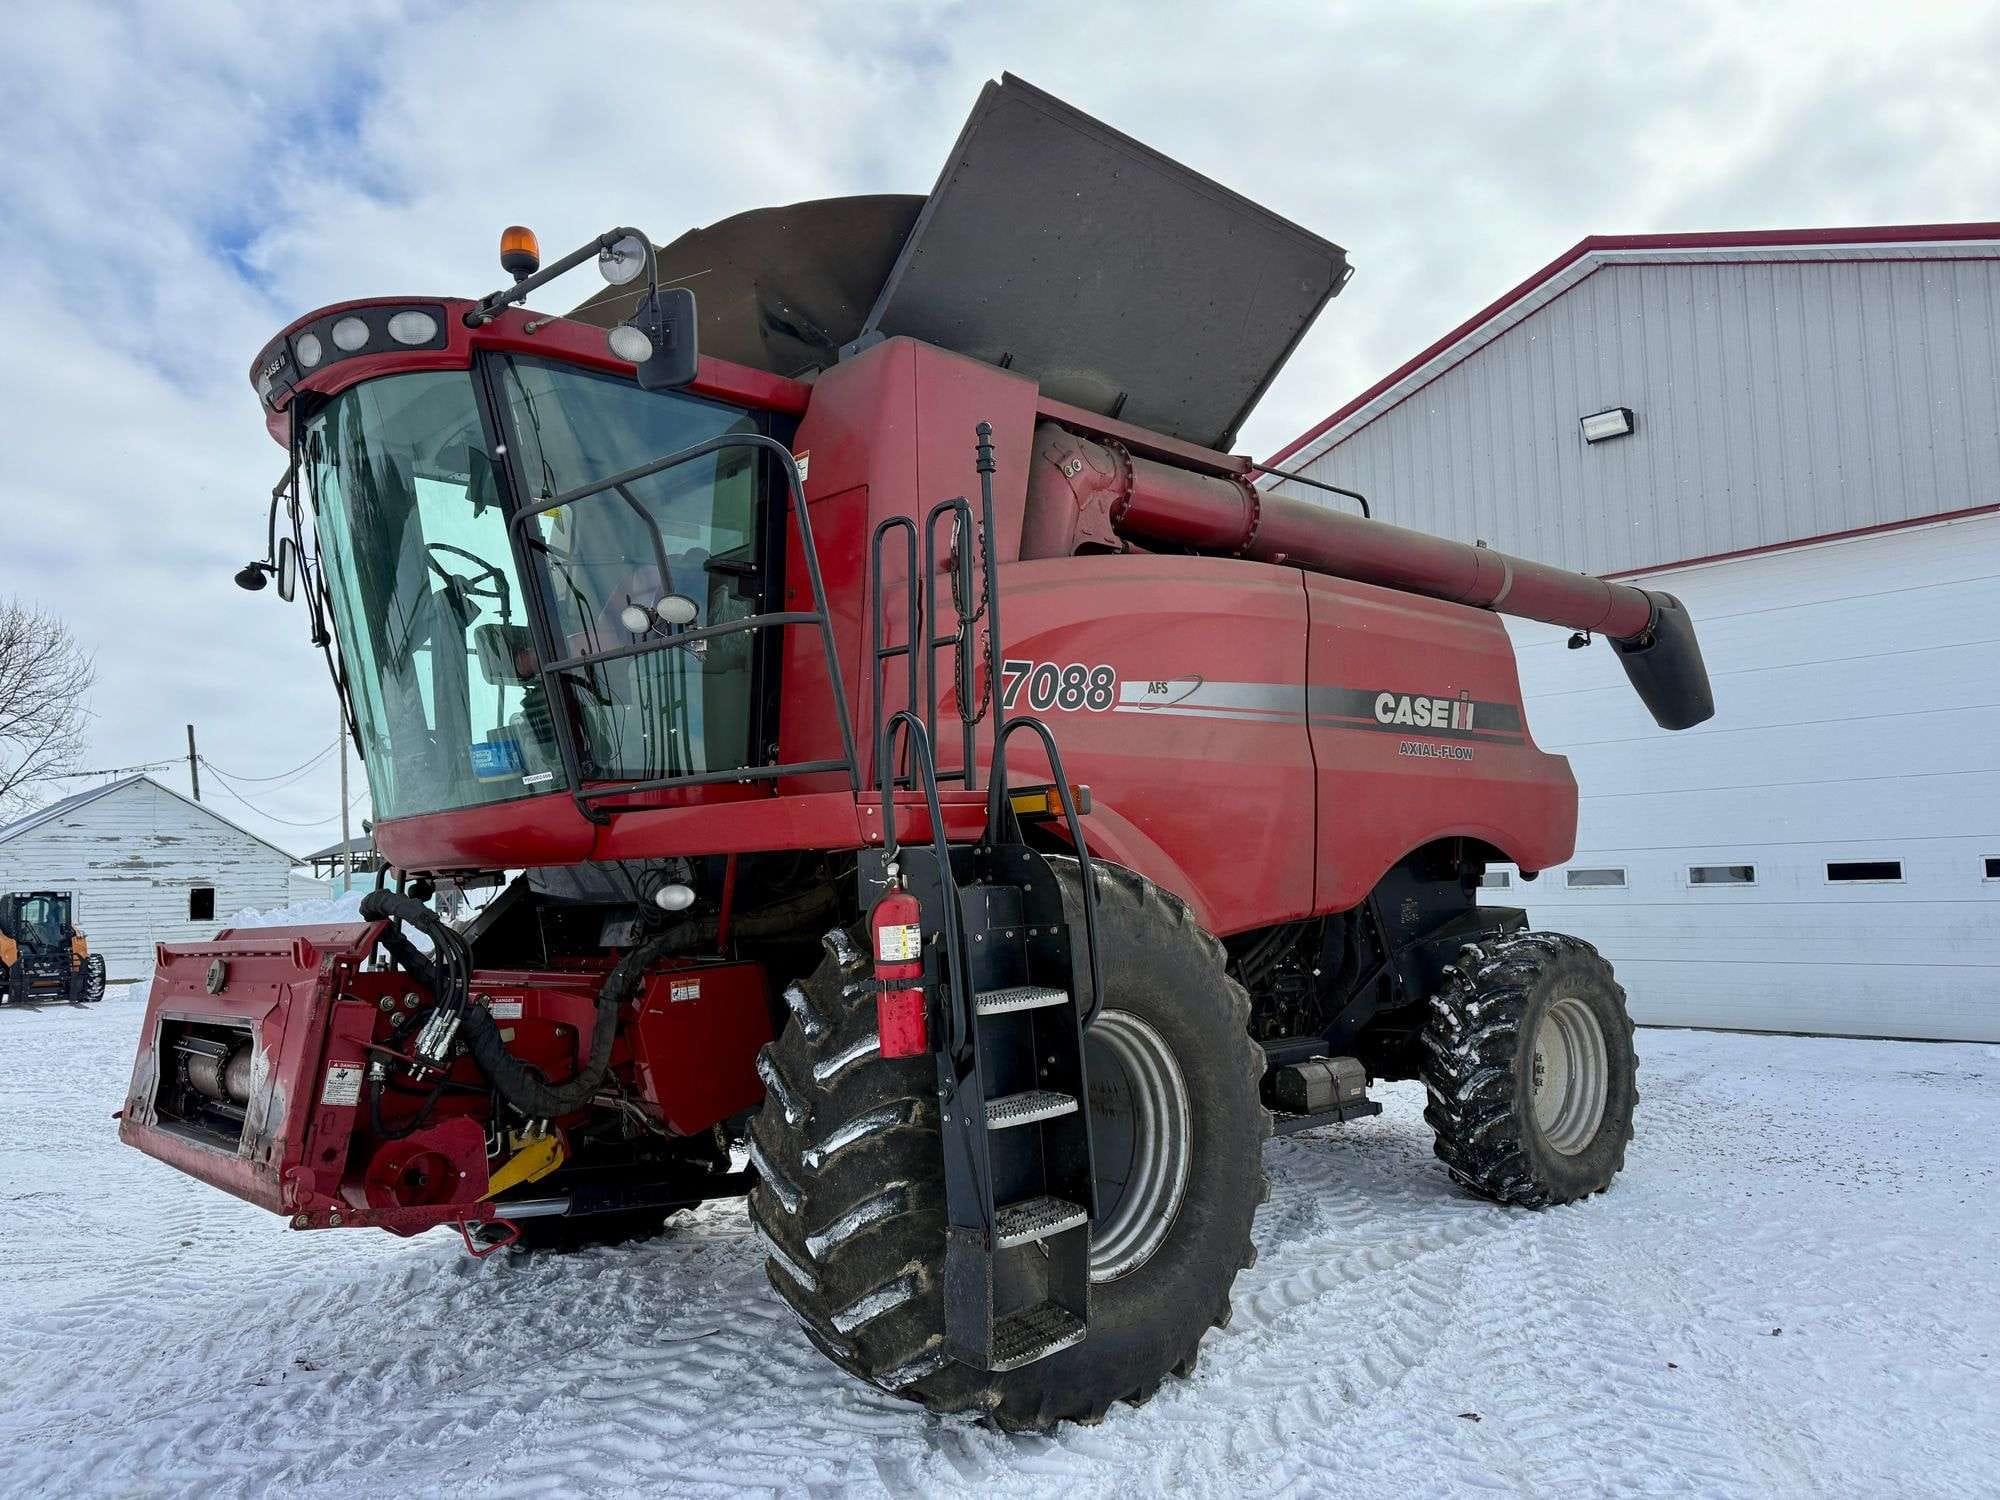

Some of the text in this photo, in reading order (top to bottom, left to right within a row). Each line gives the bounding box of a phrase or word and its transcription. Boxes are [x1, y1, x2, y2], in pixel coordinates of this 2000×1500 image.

[1002, 659, 1116, 713] 7088
[1147, 682, 1169, 695] AFS
[1374, 692, 1450, 728] CASE
[1399, 741, 1474, 761] AXIAL-FLOW
